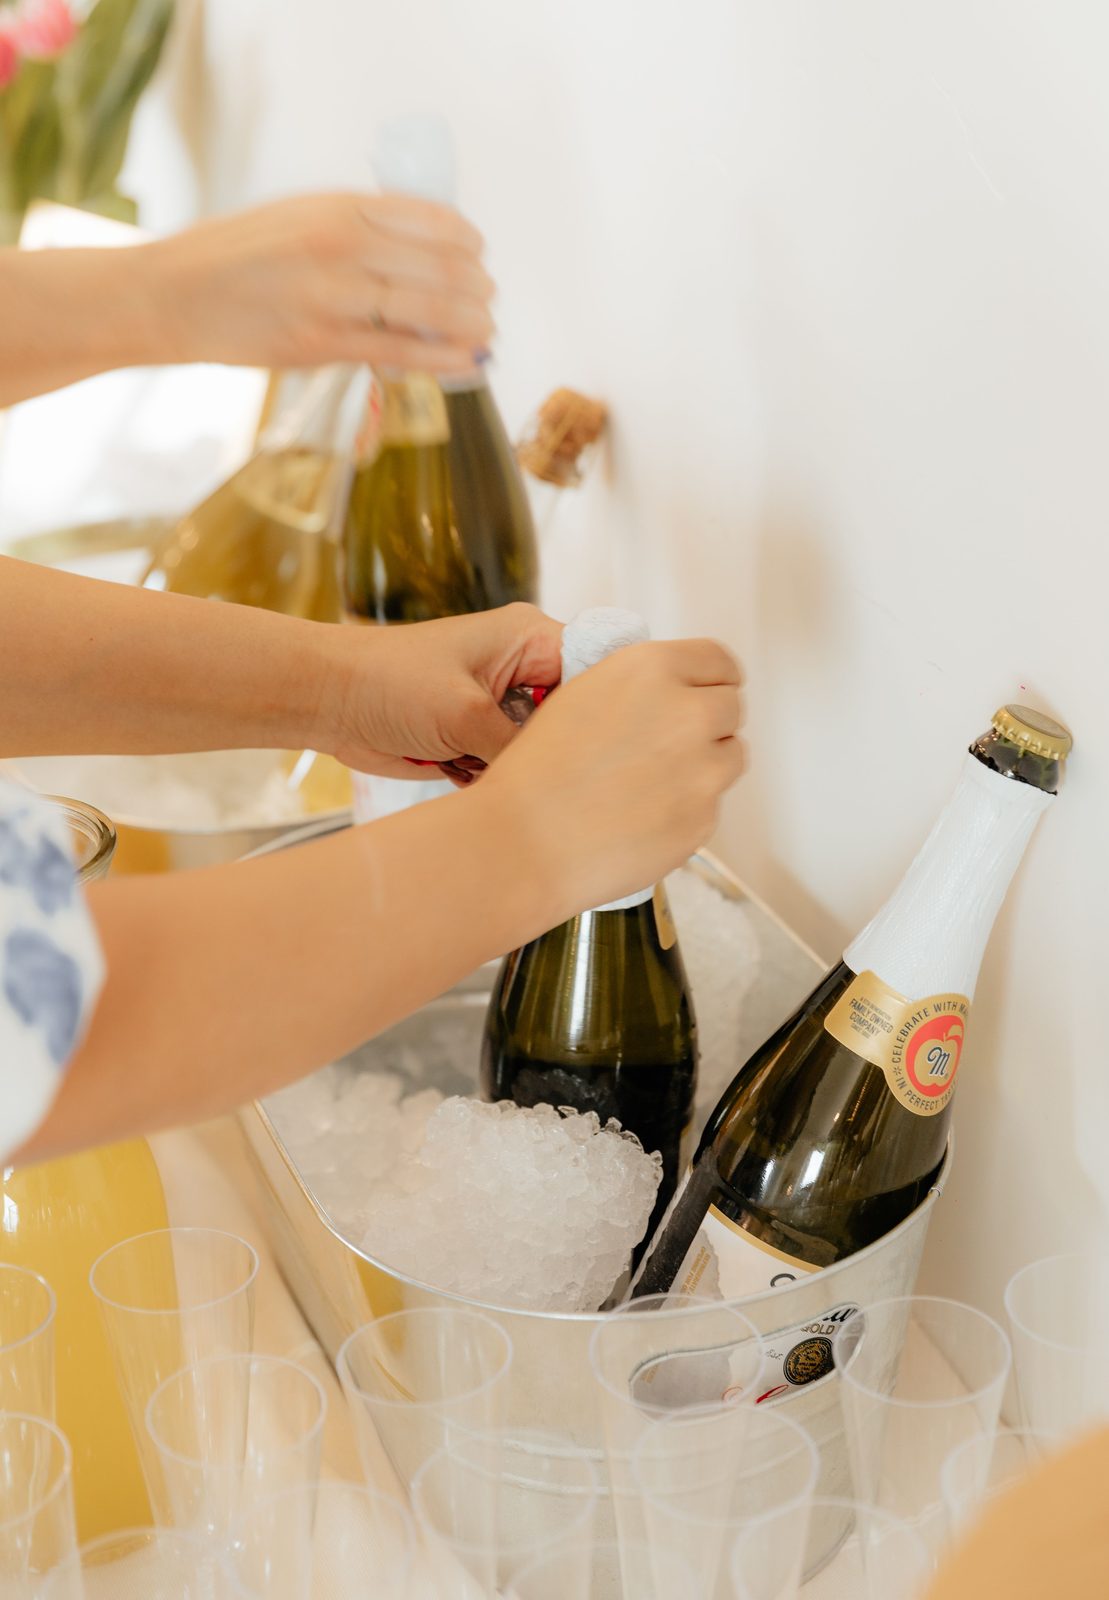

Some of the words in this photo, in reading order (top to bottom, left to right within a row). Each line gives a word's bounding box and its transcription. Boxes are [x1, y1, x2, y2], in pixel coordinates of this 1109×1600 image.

[849, 998, 871, 1018] FAMILY
[869, 1013, 894, 1034] OWNED
[849, 1013, 881, 1037] COMPANY
[892, 1007, 930, 1064] CELEBRATE
[933, 1001, 958, 1013] WITH
[896, 1078, 908, 1090] IN
[904, 1089, 939, 1111] PERFECT
